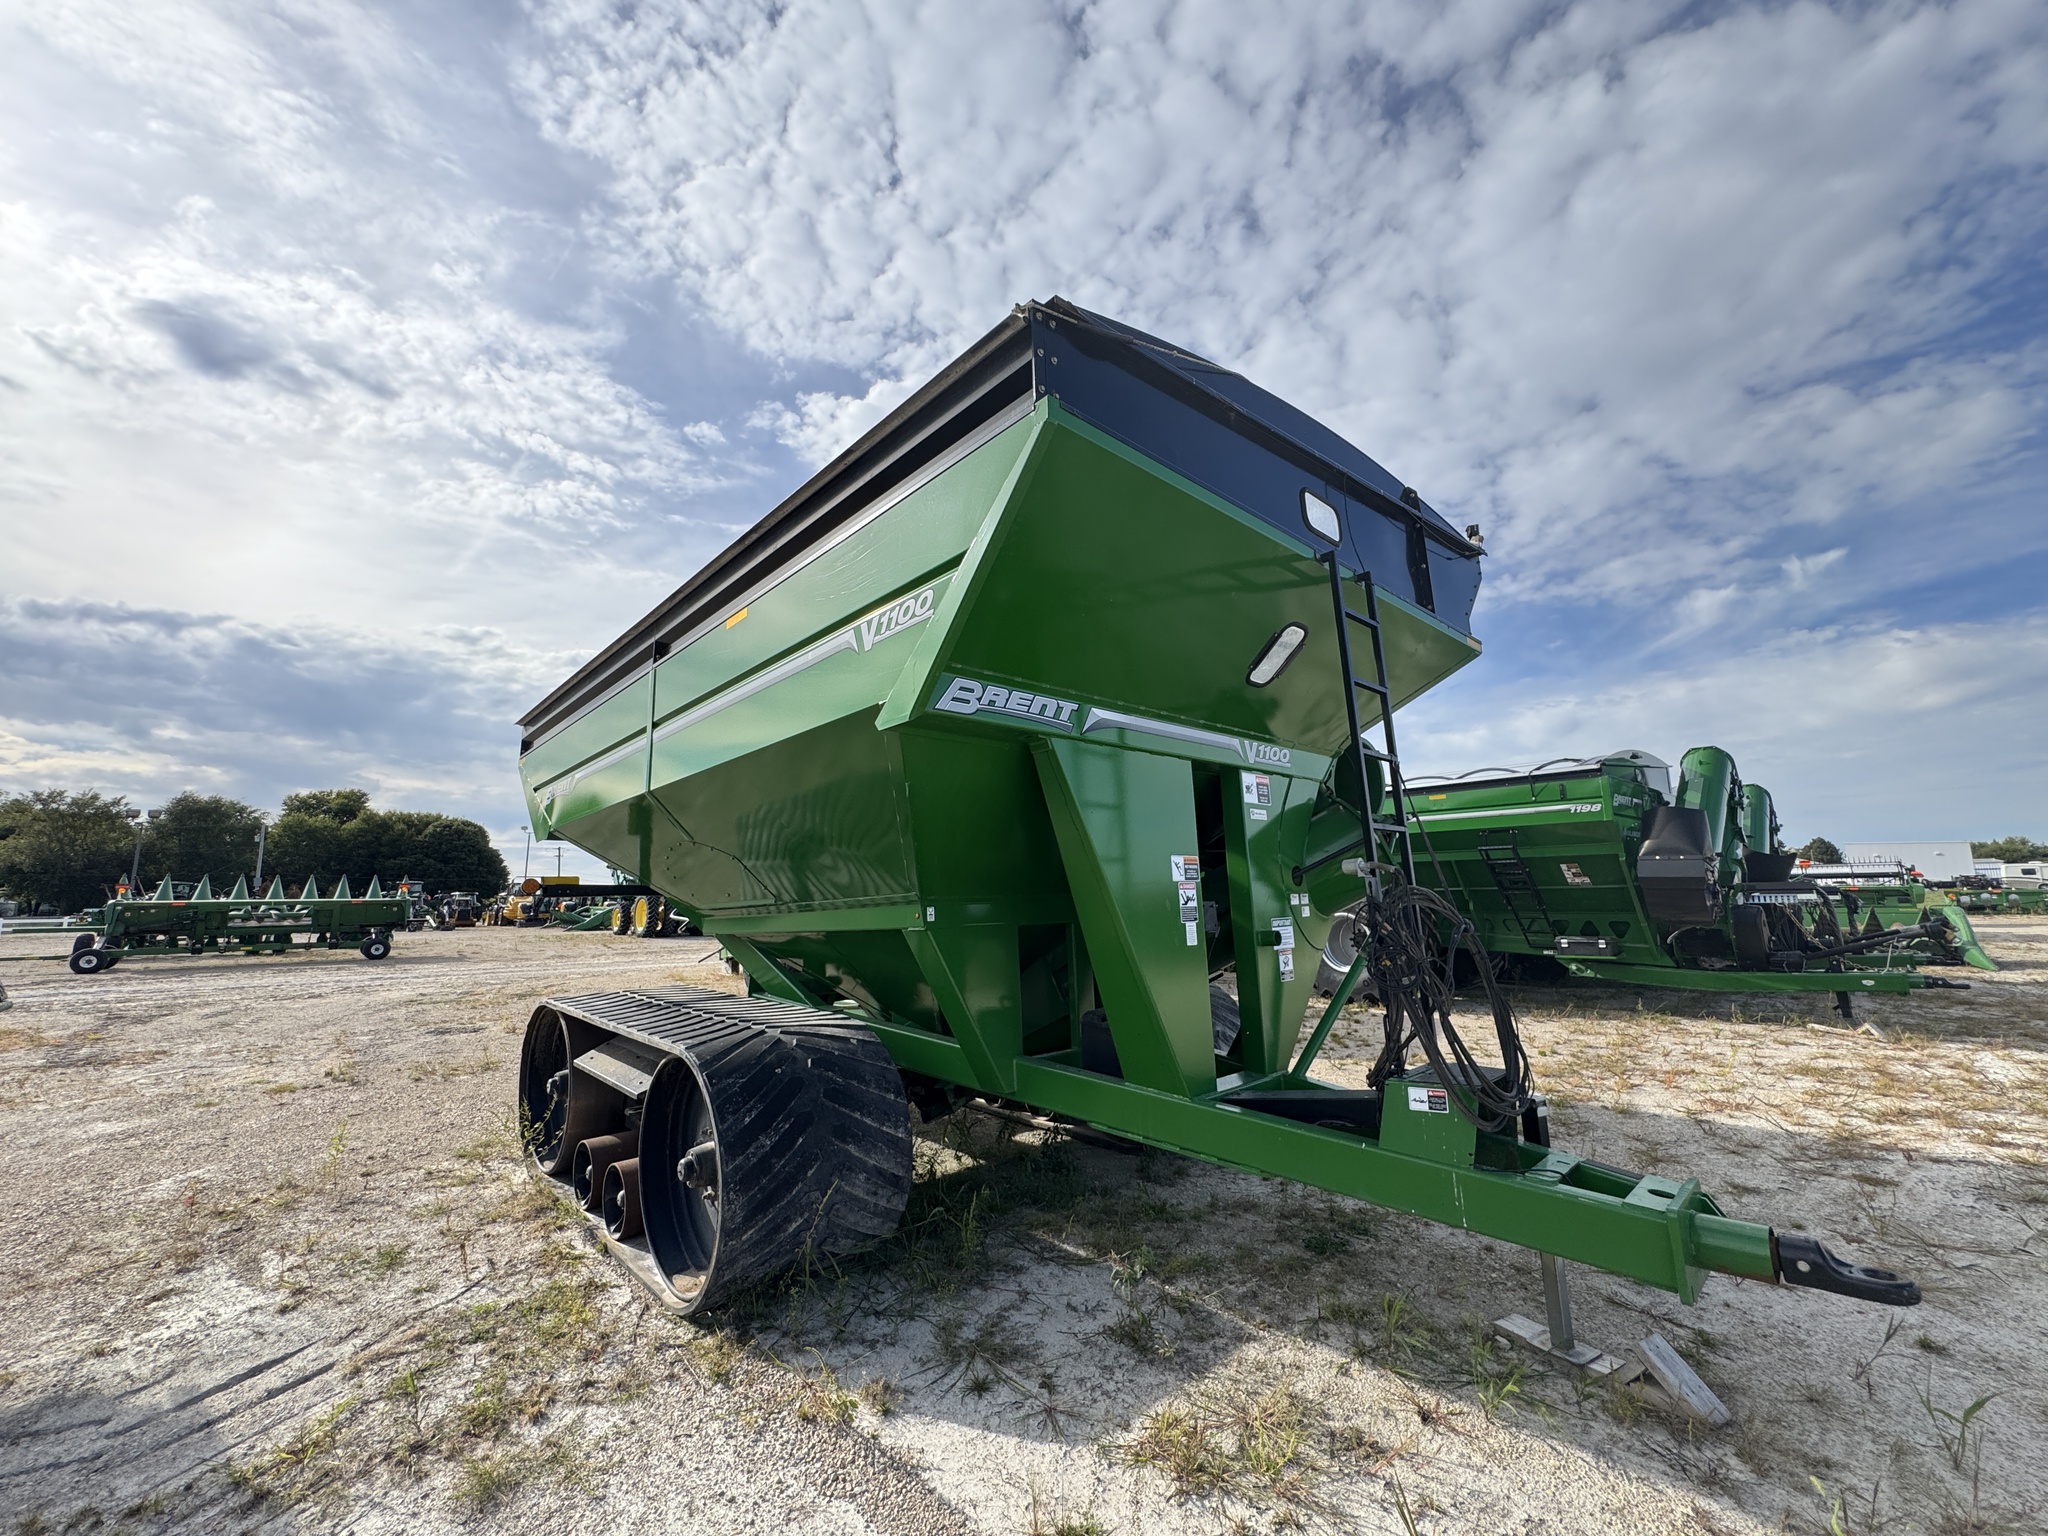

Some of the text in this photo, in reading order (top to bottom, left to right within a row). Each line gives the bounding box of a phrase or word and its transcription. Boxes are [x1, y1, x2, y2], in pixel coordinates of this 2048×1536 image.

[860, 589, 935, 652] V1100
[935, 677, 1080, 727] BRENT
[1244, 740, 1290, 764] V1100
[1569, 803, 1602, 814] 1198
